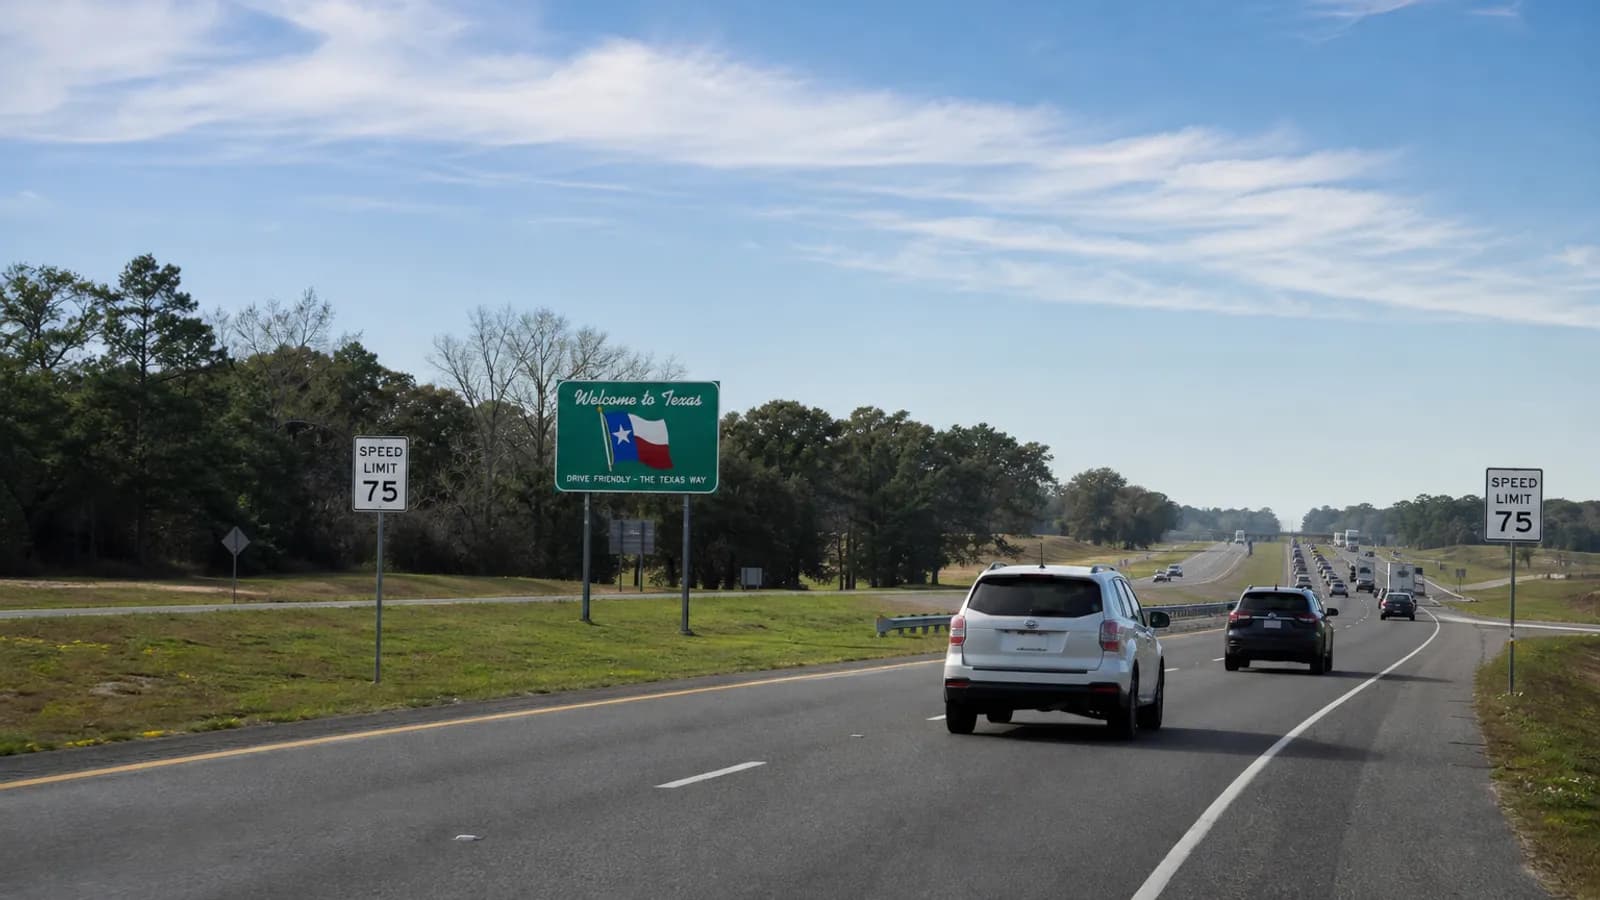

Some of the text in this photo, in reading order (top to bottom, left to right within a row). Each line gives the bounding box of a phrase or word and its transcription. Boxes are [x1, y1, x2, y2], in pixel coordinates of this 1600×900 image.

[574, 389, 702, 406] Welcome to Texas
[359, 446, 403, 457] SPEED
[364, 462, 398, 474] LIMIT
[566, 474, 590, 483] DRIVE
[593, 475, 631, 483] FRIENDLY
[640, 475, 655, 483] THE
[659, 475, 685, 484] TEXAS
[689, 476, 707, 484] WAY
[1491, 477, 1538, 488] SPEED
[363, 480, 398, 502] 75
[1496, 493, 1532, 505] LIMIT
[1495, 511, 1532, 533] 75
